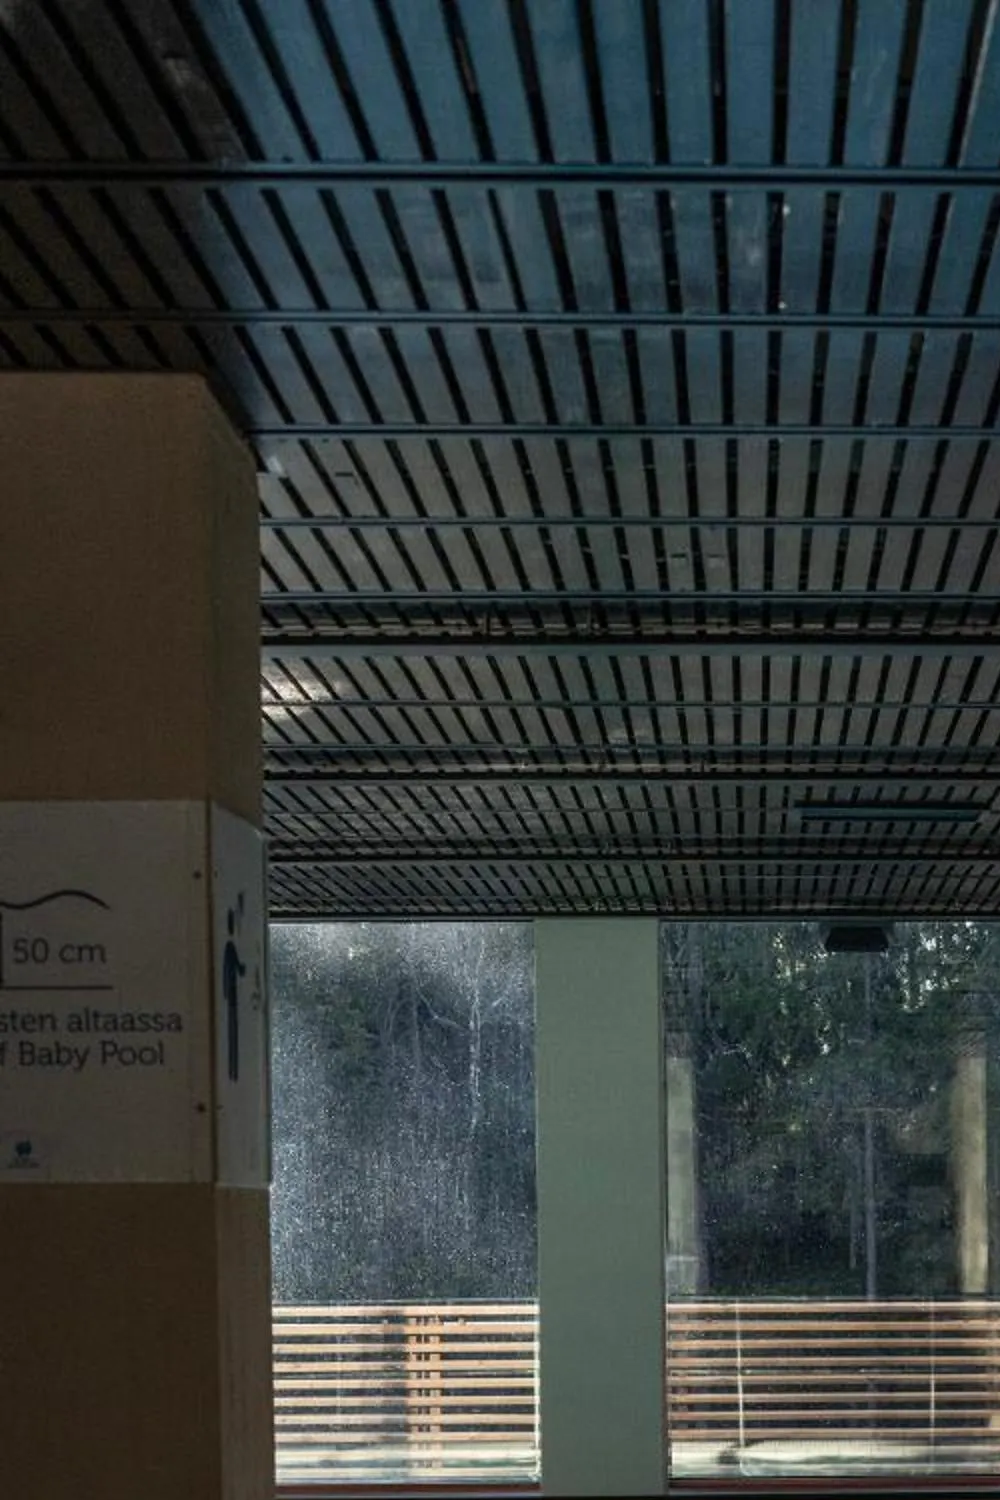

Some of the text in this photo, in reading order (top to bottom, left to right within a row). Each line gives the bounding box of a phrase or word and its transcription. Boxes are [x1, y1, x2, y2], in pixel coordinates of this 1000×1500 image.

[13, 937, 107, 964] 50 cm
[67, 1005, 183, 1034] altaassa
[18, 1039, 91, 1073] Baby
[100, 1039, 165, 1066] Pool
